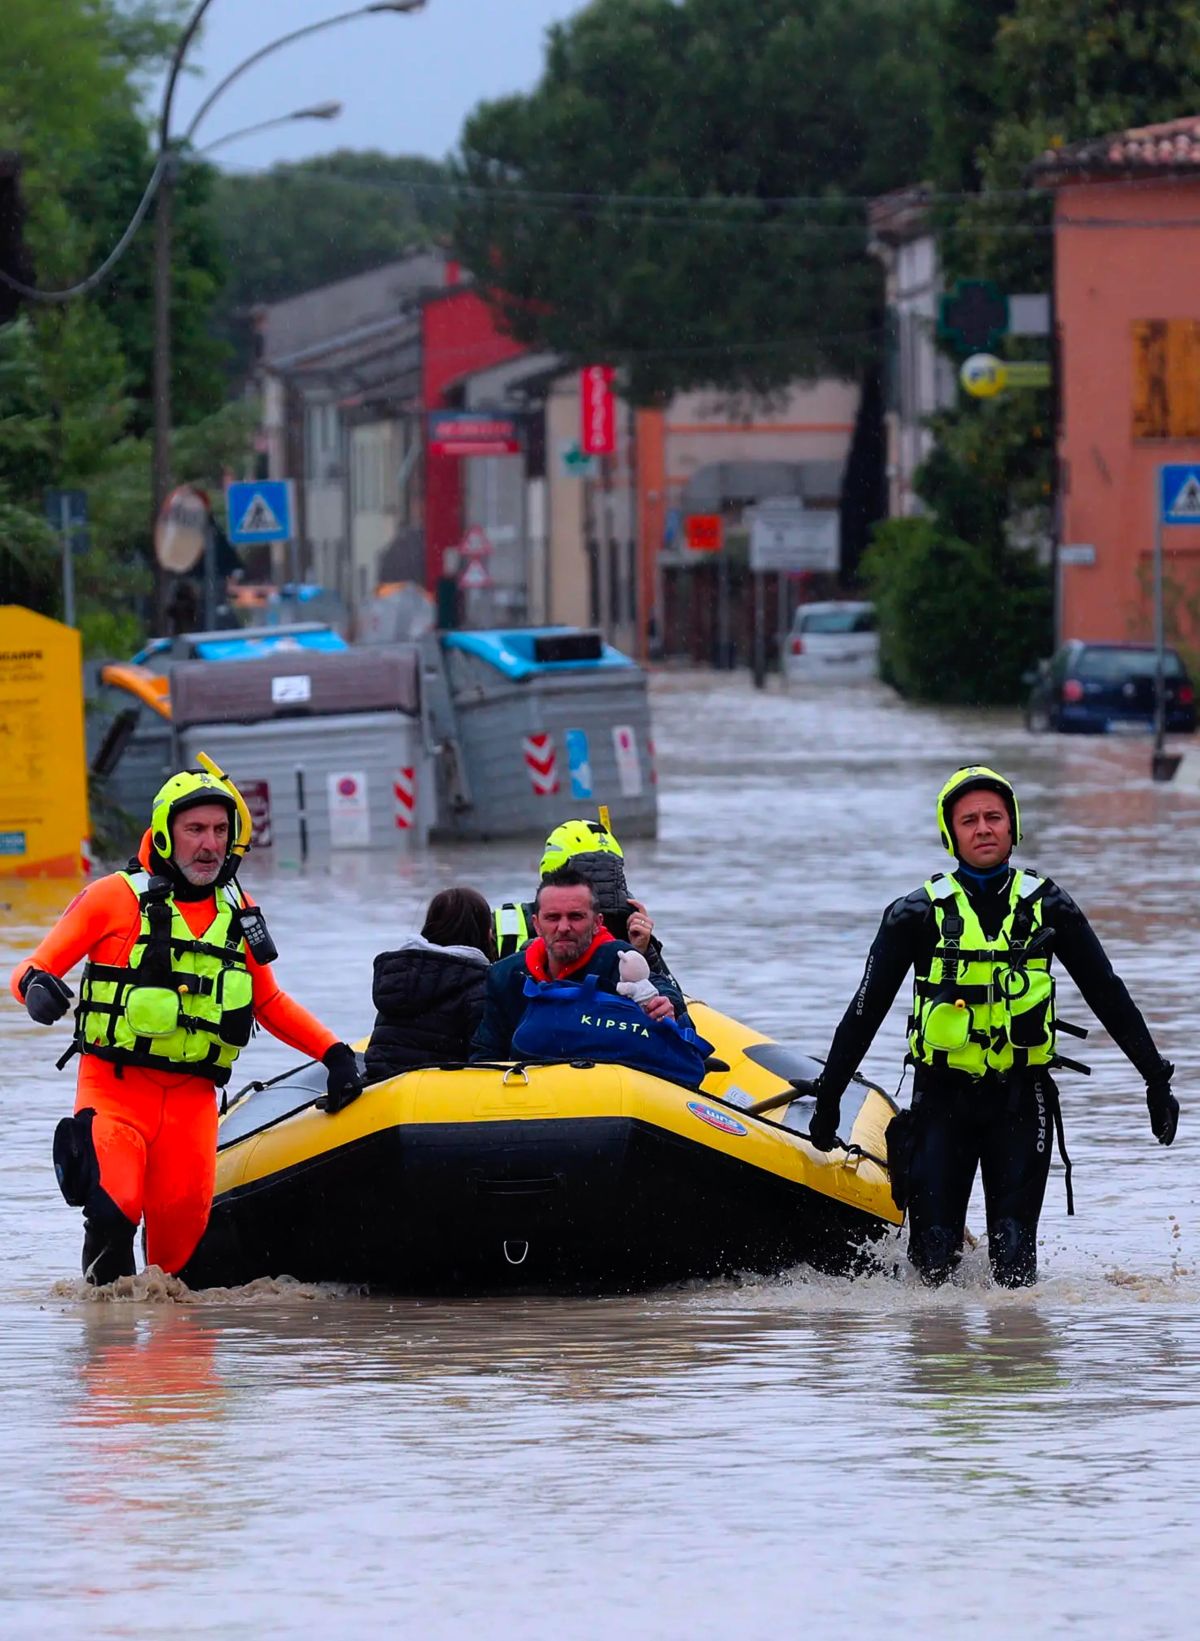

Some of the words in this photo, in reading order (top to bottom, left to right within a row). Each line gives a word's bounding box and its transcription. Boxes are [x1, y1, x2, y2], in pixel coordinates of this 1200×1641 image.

[856, 955, 874, 1016] SCUBAPRO
[580, 1014, 649, 1038] KIPSTA
[1034, 1081, 1046, 1153] UBAPRO
